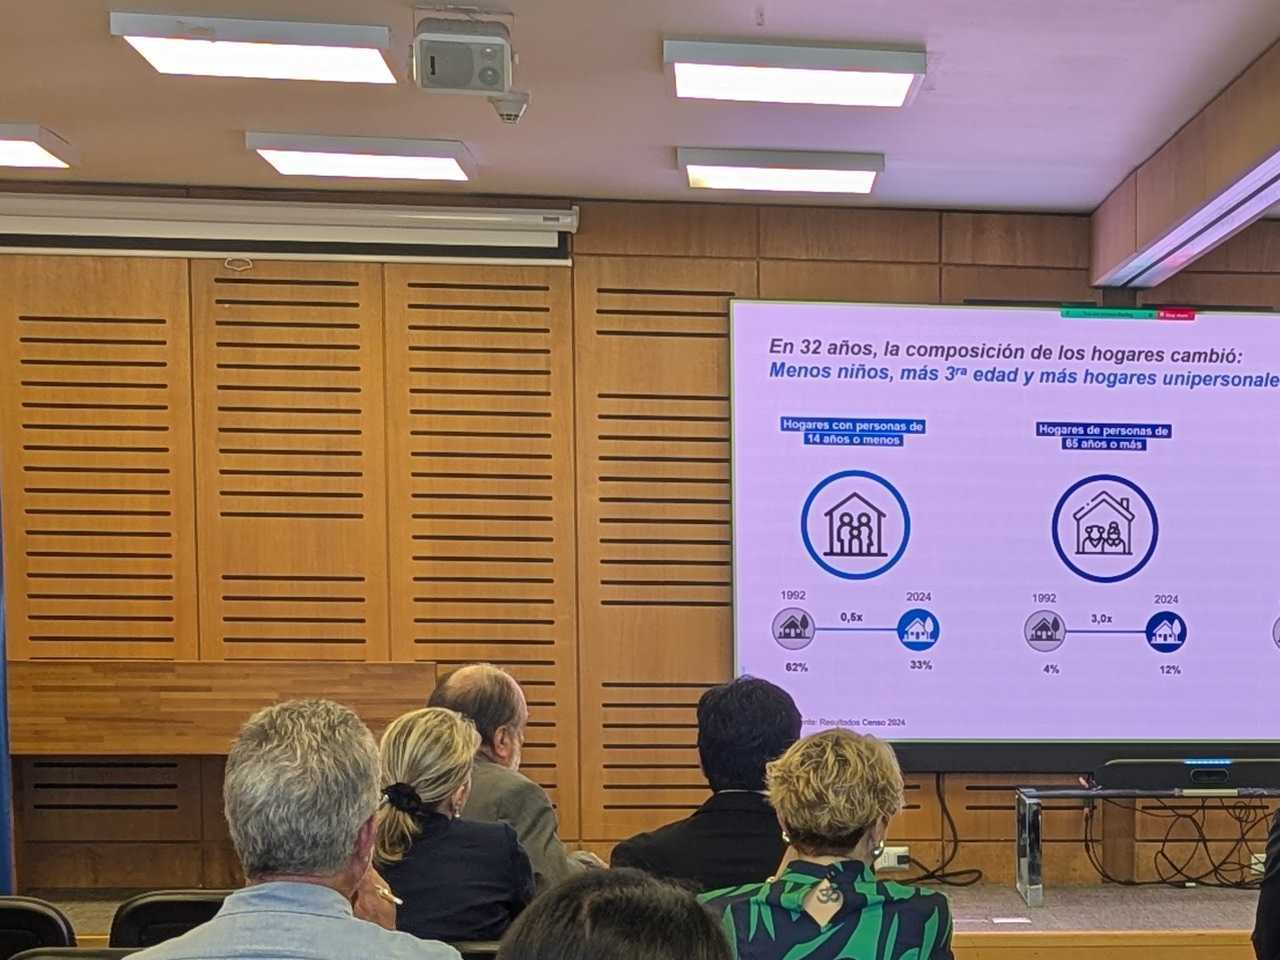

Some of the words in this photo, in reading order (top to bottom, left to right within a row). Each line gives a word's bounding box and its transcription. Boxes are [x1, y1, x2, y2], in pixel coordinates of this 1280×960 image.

[769, 338, 794, 354] En
[800, 339, 822, 354] 32
[827, 340, 877, 359] años,
[884, 341, 900, 357] la
[906, 343, 1025, 361] composición
[1031, 344, 1053, 360] de
[1058, 345, 1085, 361] los
[1091, 346, 1165, 365] hogares
[1171, 347, 1243, 364] cambió:
[770, 362, 832, 378] Menos
[837, 364, 893, 382] niños,
[900, 365, 939, 381] más
[973, 367, 1019, 382] edad
[1022, 371, 1035, 386] y
[1040, 368, 1078, 383] más
[1083, 369, 1157, 388] hogares
[783, 419, 829, 431] Hogares
[832, 422, 853, 430] con
[856, 422, 906, 432] personas
[909, 421, 923, 431] de
[1040, 424, 1084, 436] Hogares
[1087, 425, 1100, 435] de
[1103, 427, 1152, 437] personas
[1155, 426, 1168, 436] de
[808, 434, 820, 443] 14
[823, 434, 850, 444] años
[853, 436, 860, 444] o
[863, 436, 900, 445] menos
[1081, 438, 1107, 449] años
[1110, 441, 1118, 449] o
[1120, 439, 1142, 449] más
[781, 590, 806, 600] 1992
[906, 592, 931, 602] 2024
[1033, 593, 1057, 604] 1992
[1154, 594, 1179, 605] 2024
[1091, 614, 1112, 625] 3,0x
[785, 662, 808, 672] 62%
[910, 660, 932, 670] 33%
[1043, 664, 1060, 674] 4%
[1160, 665, 1181, 675] 12%
[863, 718, 886, 726] Censo
[887, 718, 906, 726] 2024
